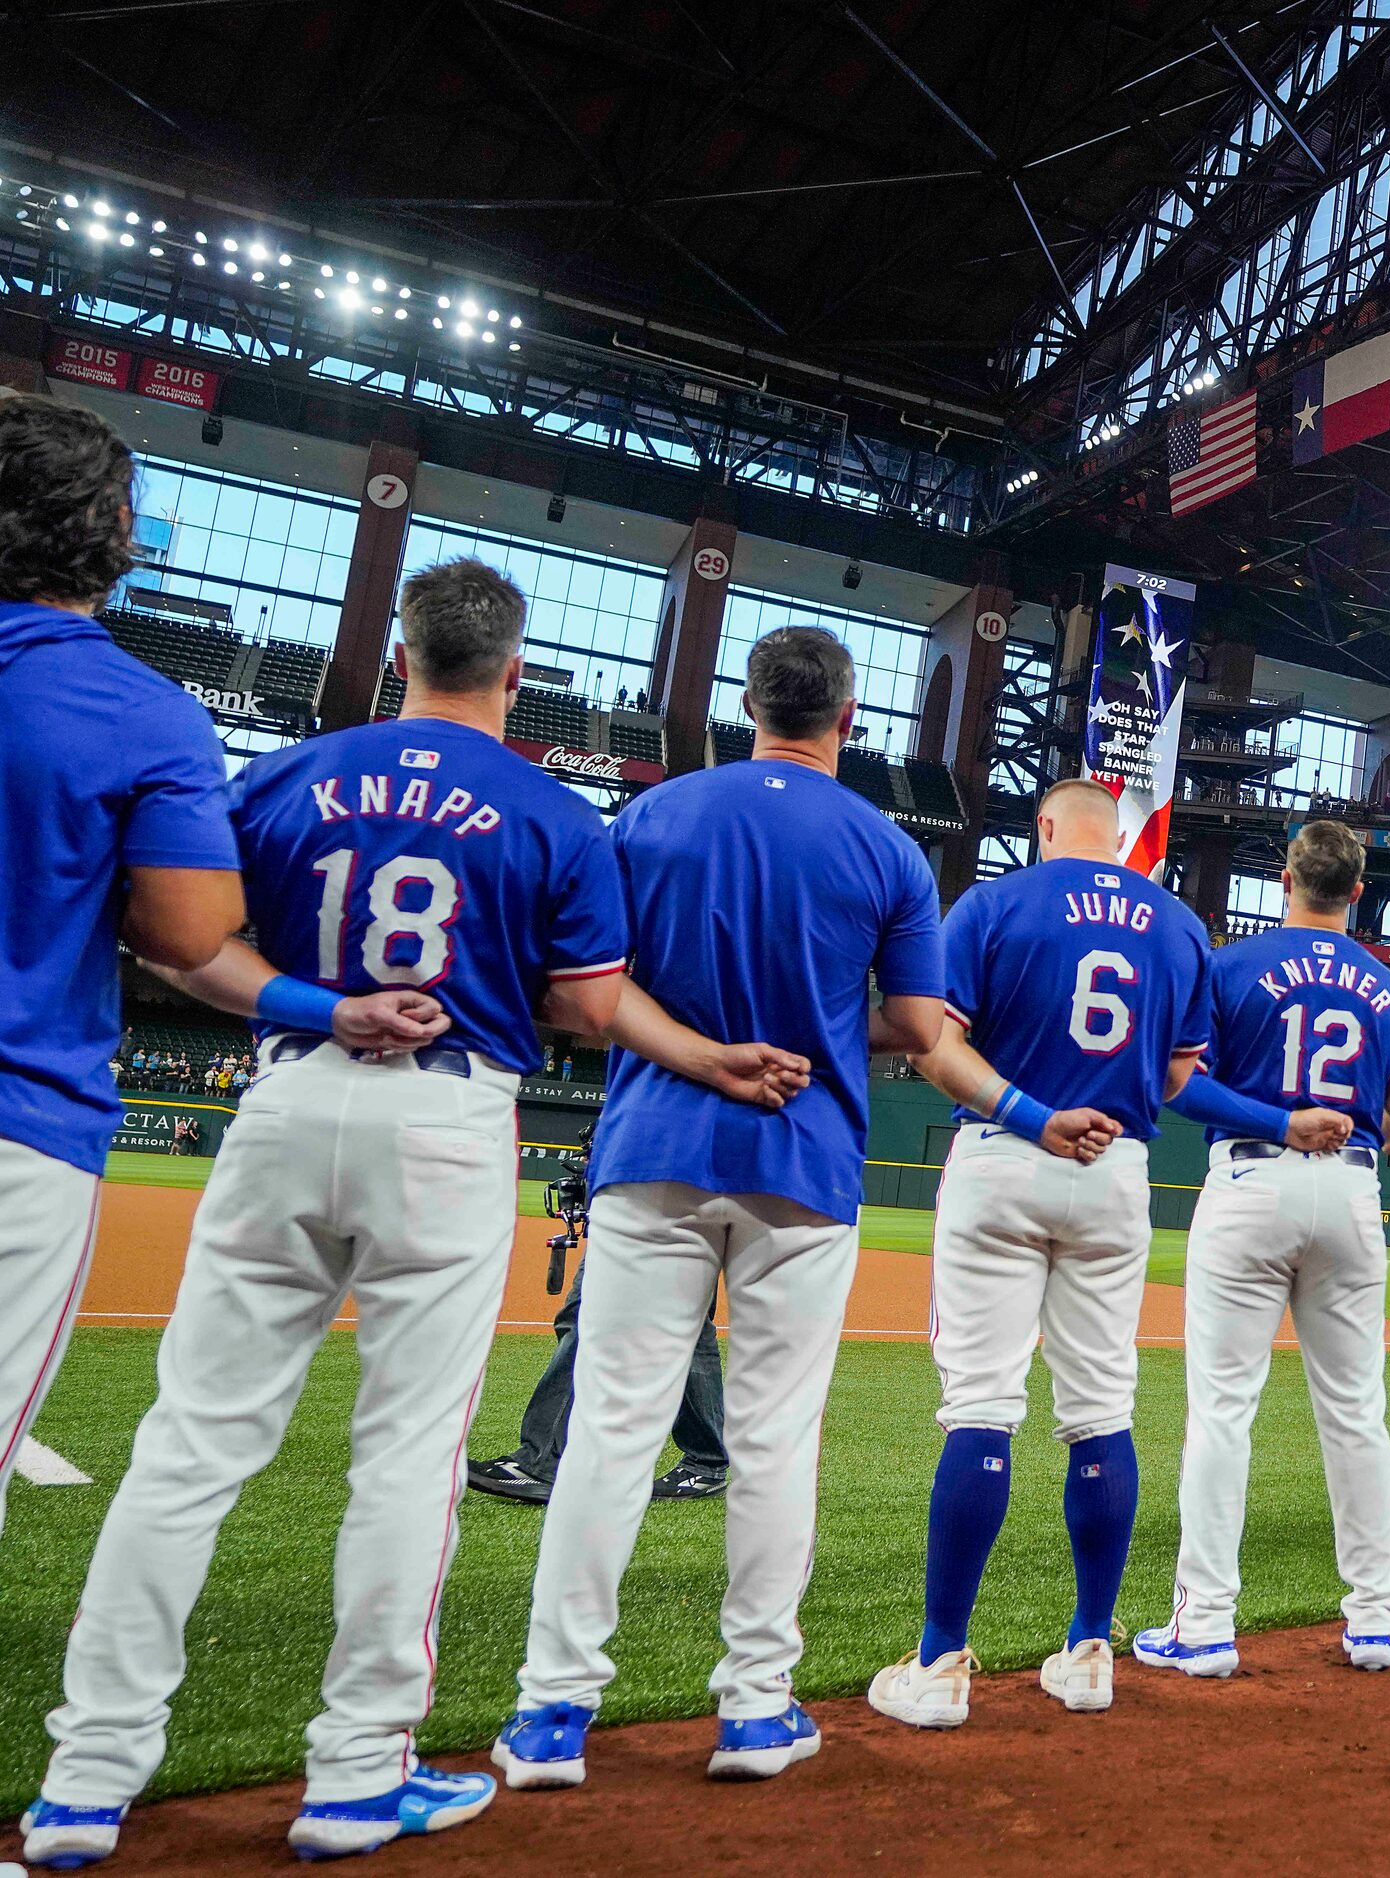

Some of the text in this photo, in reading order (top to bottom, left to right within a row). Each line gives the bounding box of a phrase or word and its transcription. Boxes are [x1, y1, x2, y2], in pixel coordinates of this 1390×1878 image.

[65, 341, 118, 367] 2015
[56, 365, 117, 385] CHAMPIONS
[61, 361, 114, 378] WEST DIVISION
[154, 363, 204, 388] 2016
[145, 386, 204, 406] CHAMPIONS
[151, 383, 201, 399] WEST DIVISION
[378, 480, 397, 501] 7
[697, 552, 725, 575] 29
[1136, 573, 1167, 590] 7:02
[982, 616, 999, 636] 10
[182, 680, 265, 716] Bank
[1112, 702, 1159, 720] OH SAY
[1098, 713, 1168, 736] DOES THAT
[1114, 731, 1151, 746] STAR-
[1098, 742, 1162, 762] SPANGLED
[1104, 757, 1154, 775] BANNER
[1095, 769, 1160, 791] YET WAVE
[311, 775, 502, 838] KNAPP
[921, 816, 963, 830] RESORTS
[312, 848, 463, 991] 18
[1065, 892, 1154, 934] JUNG
[1068, 949, 1140, 1056] 6
[1280, 1003, 1364, 1102] 12
[536, 1087, 562, 1096] STAY
[120, 1136, 127, 1144] &
